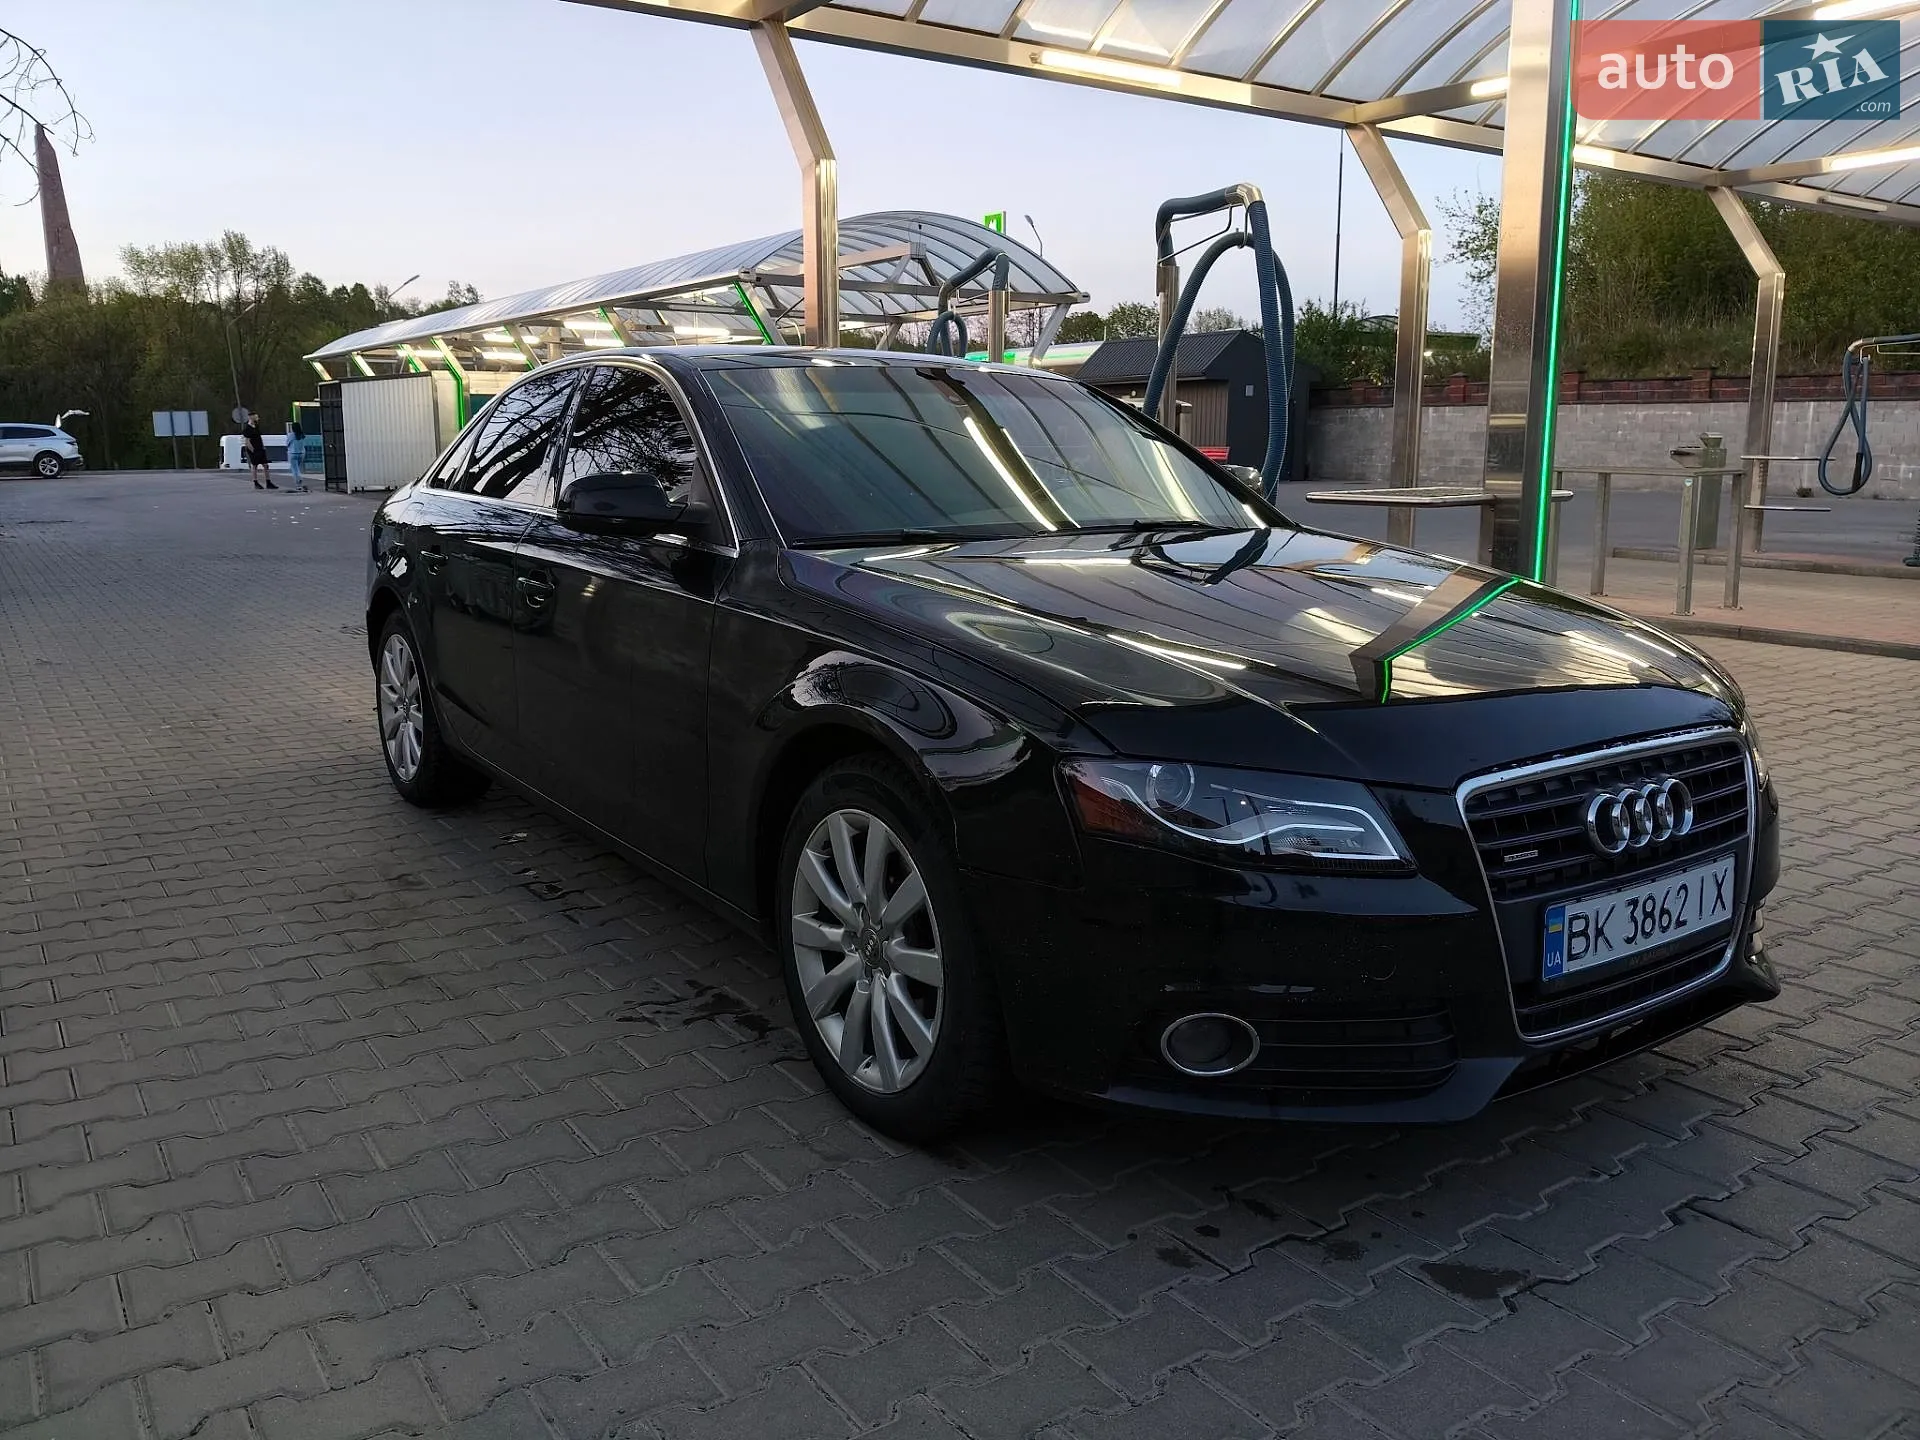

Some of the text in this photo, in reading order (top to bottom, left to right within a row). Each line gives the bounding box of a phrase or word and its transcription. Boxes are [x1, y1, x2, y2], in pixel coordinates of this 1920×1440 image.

[1567, 902, 1616, 963] BK
[1623, 880, 1690, 945] 3862
[1698, 866, 1729, 921] IX
[1547, 950, 1562, 968] UA
